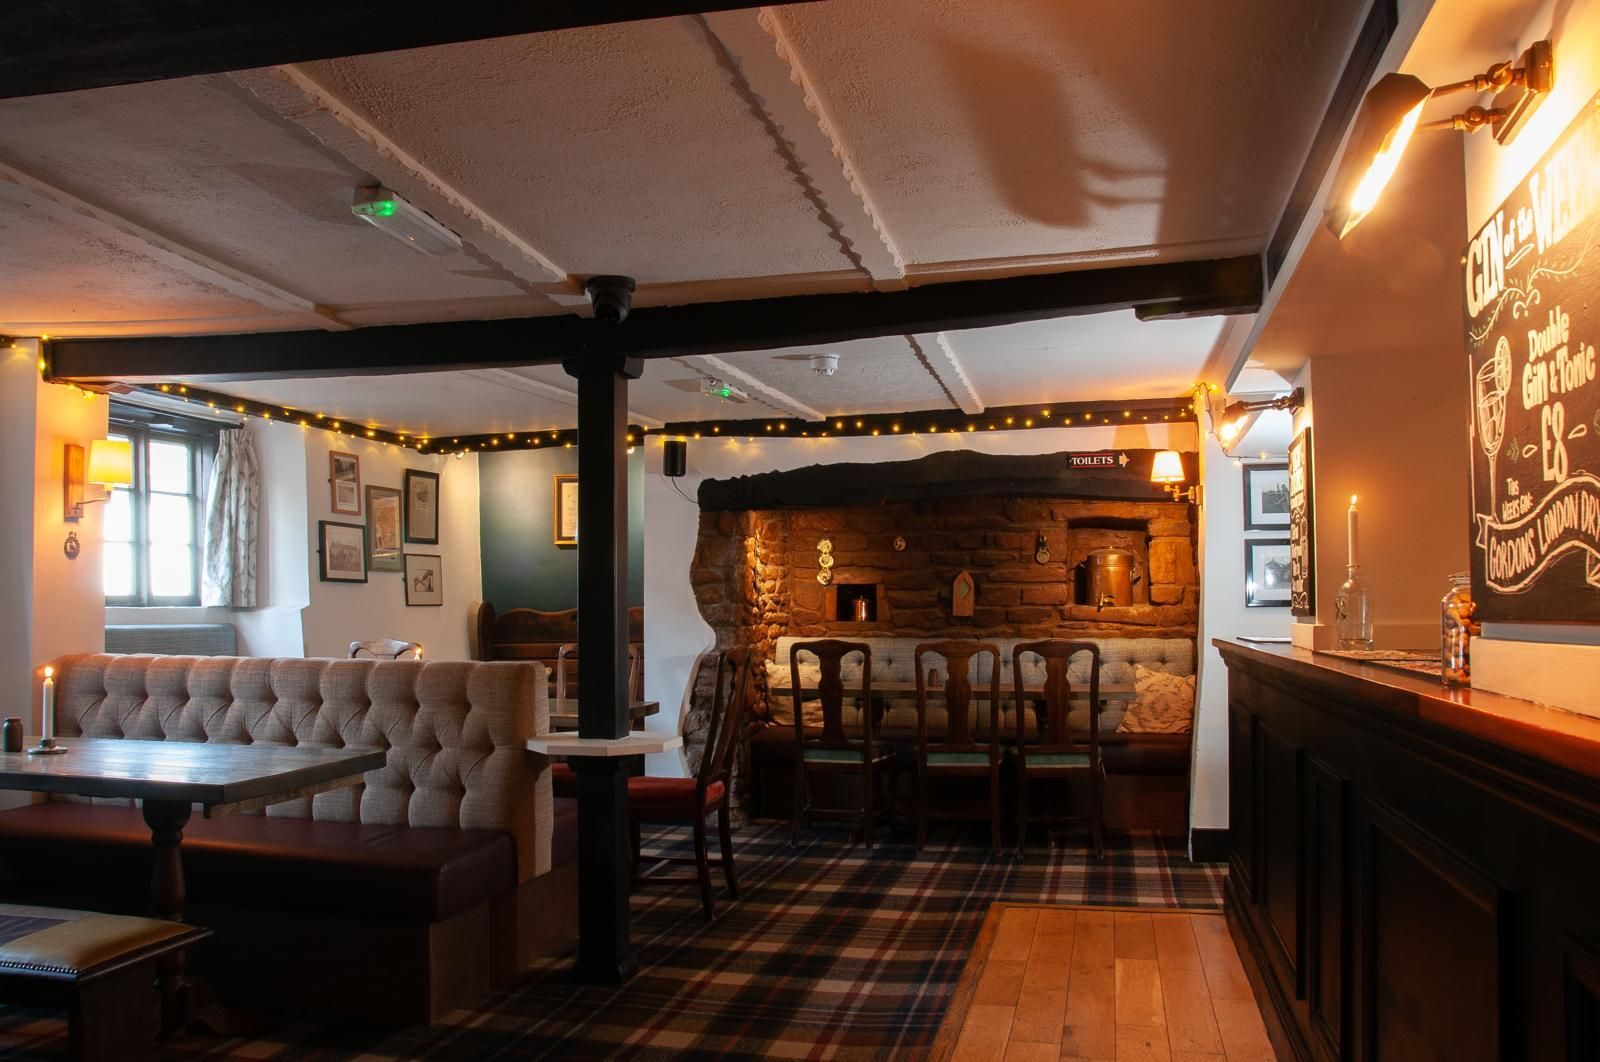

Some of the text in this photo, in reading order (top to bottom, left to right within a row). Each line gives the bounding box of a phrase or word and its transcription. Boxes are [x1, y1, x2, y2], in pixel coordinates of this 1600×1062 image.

[1466, 210, 1505, 317] GIN
[1504, 219, 1515, 257] of
[1517, 206, 1533, 243] the
[1528, 305, 1570, 362] Double
[1522, 342, 1596, 410] Gin & Tonic
[1071, 456, 1114, 465] TOILETS
[1489, 528, 1536, 580] GORDONS
[1537, 491, 1579, 555] LONDON
